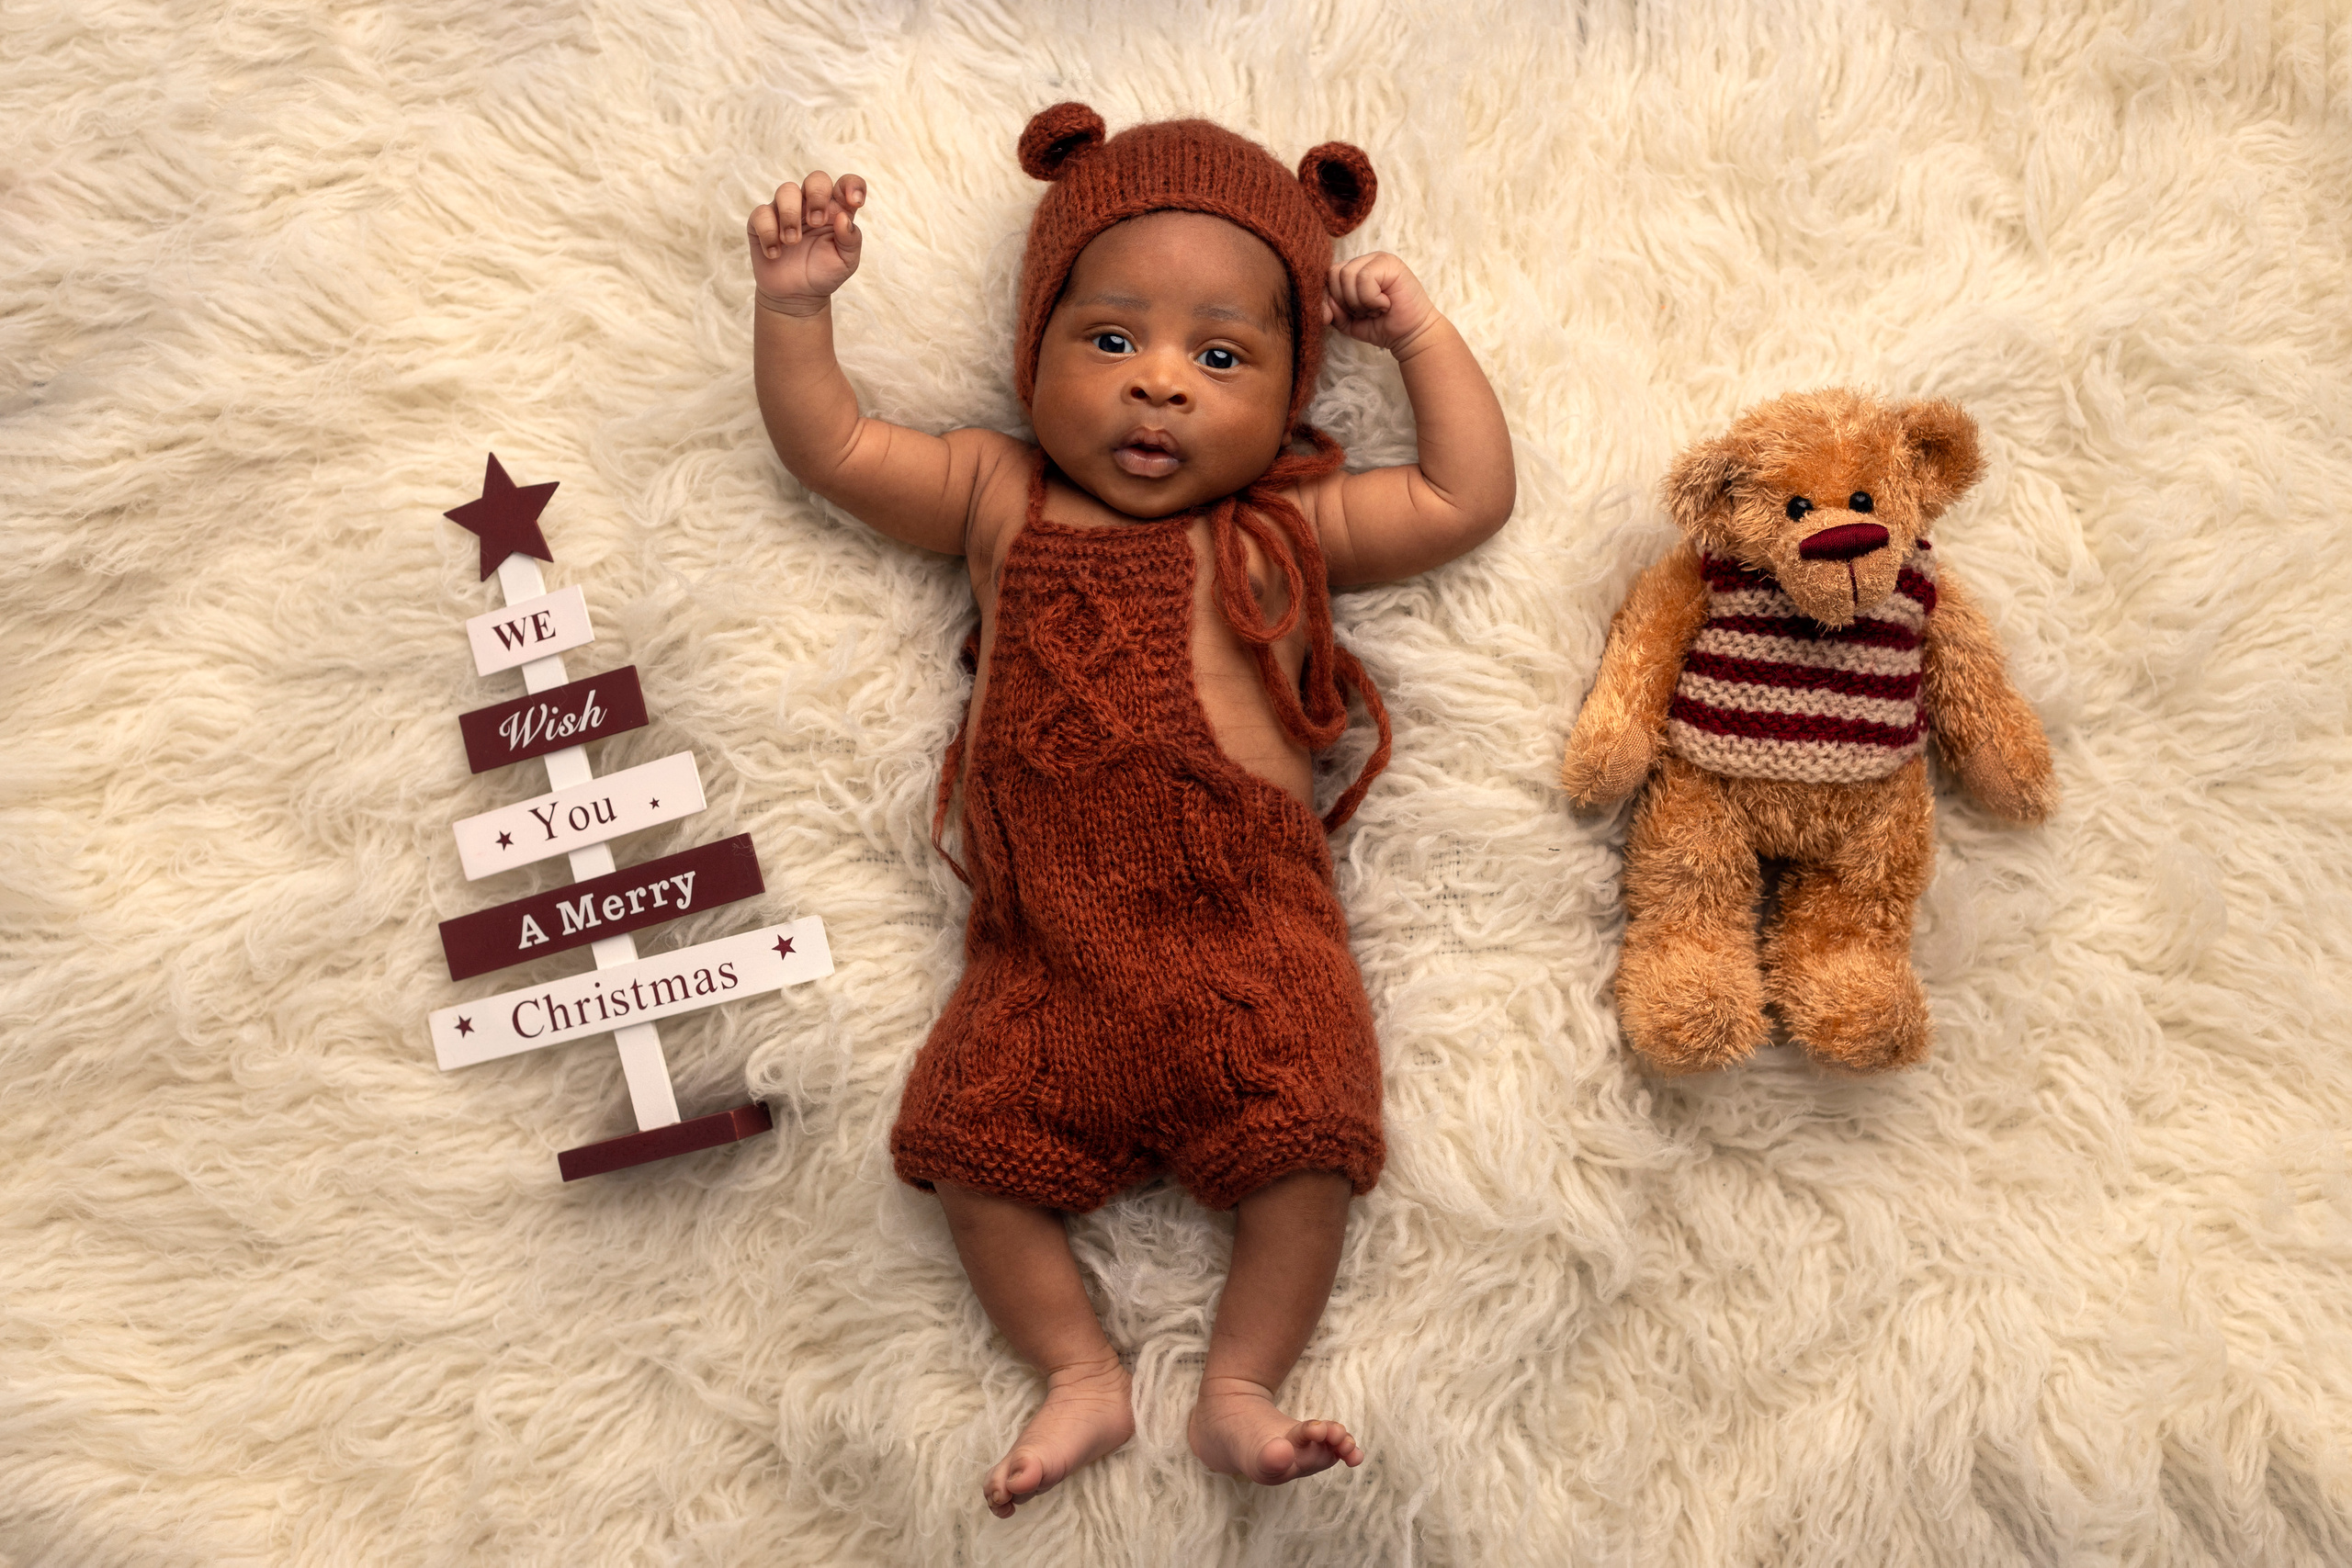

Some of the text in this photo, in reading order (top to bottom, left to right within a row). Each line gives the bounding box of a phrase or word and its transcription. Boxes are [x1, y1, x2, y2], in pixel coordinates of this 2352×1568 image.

[492, 610, 557, 651] WE
[499, 690, 607, 751] Wish
[528, 796, 618, 840] You
[517, 870, 697, 950] A Merry
[511, 961, 740, 1039] Christmas
